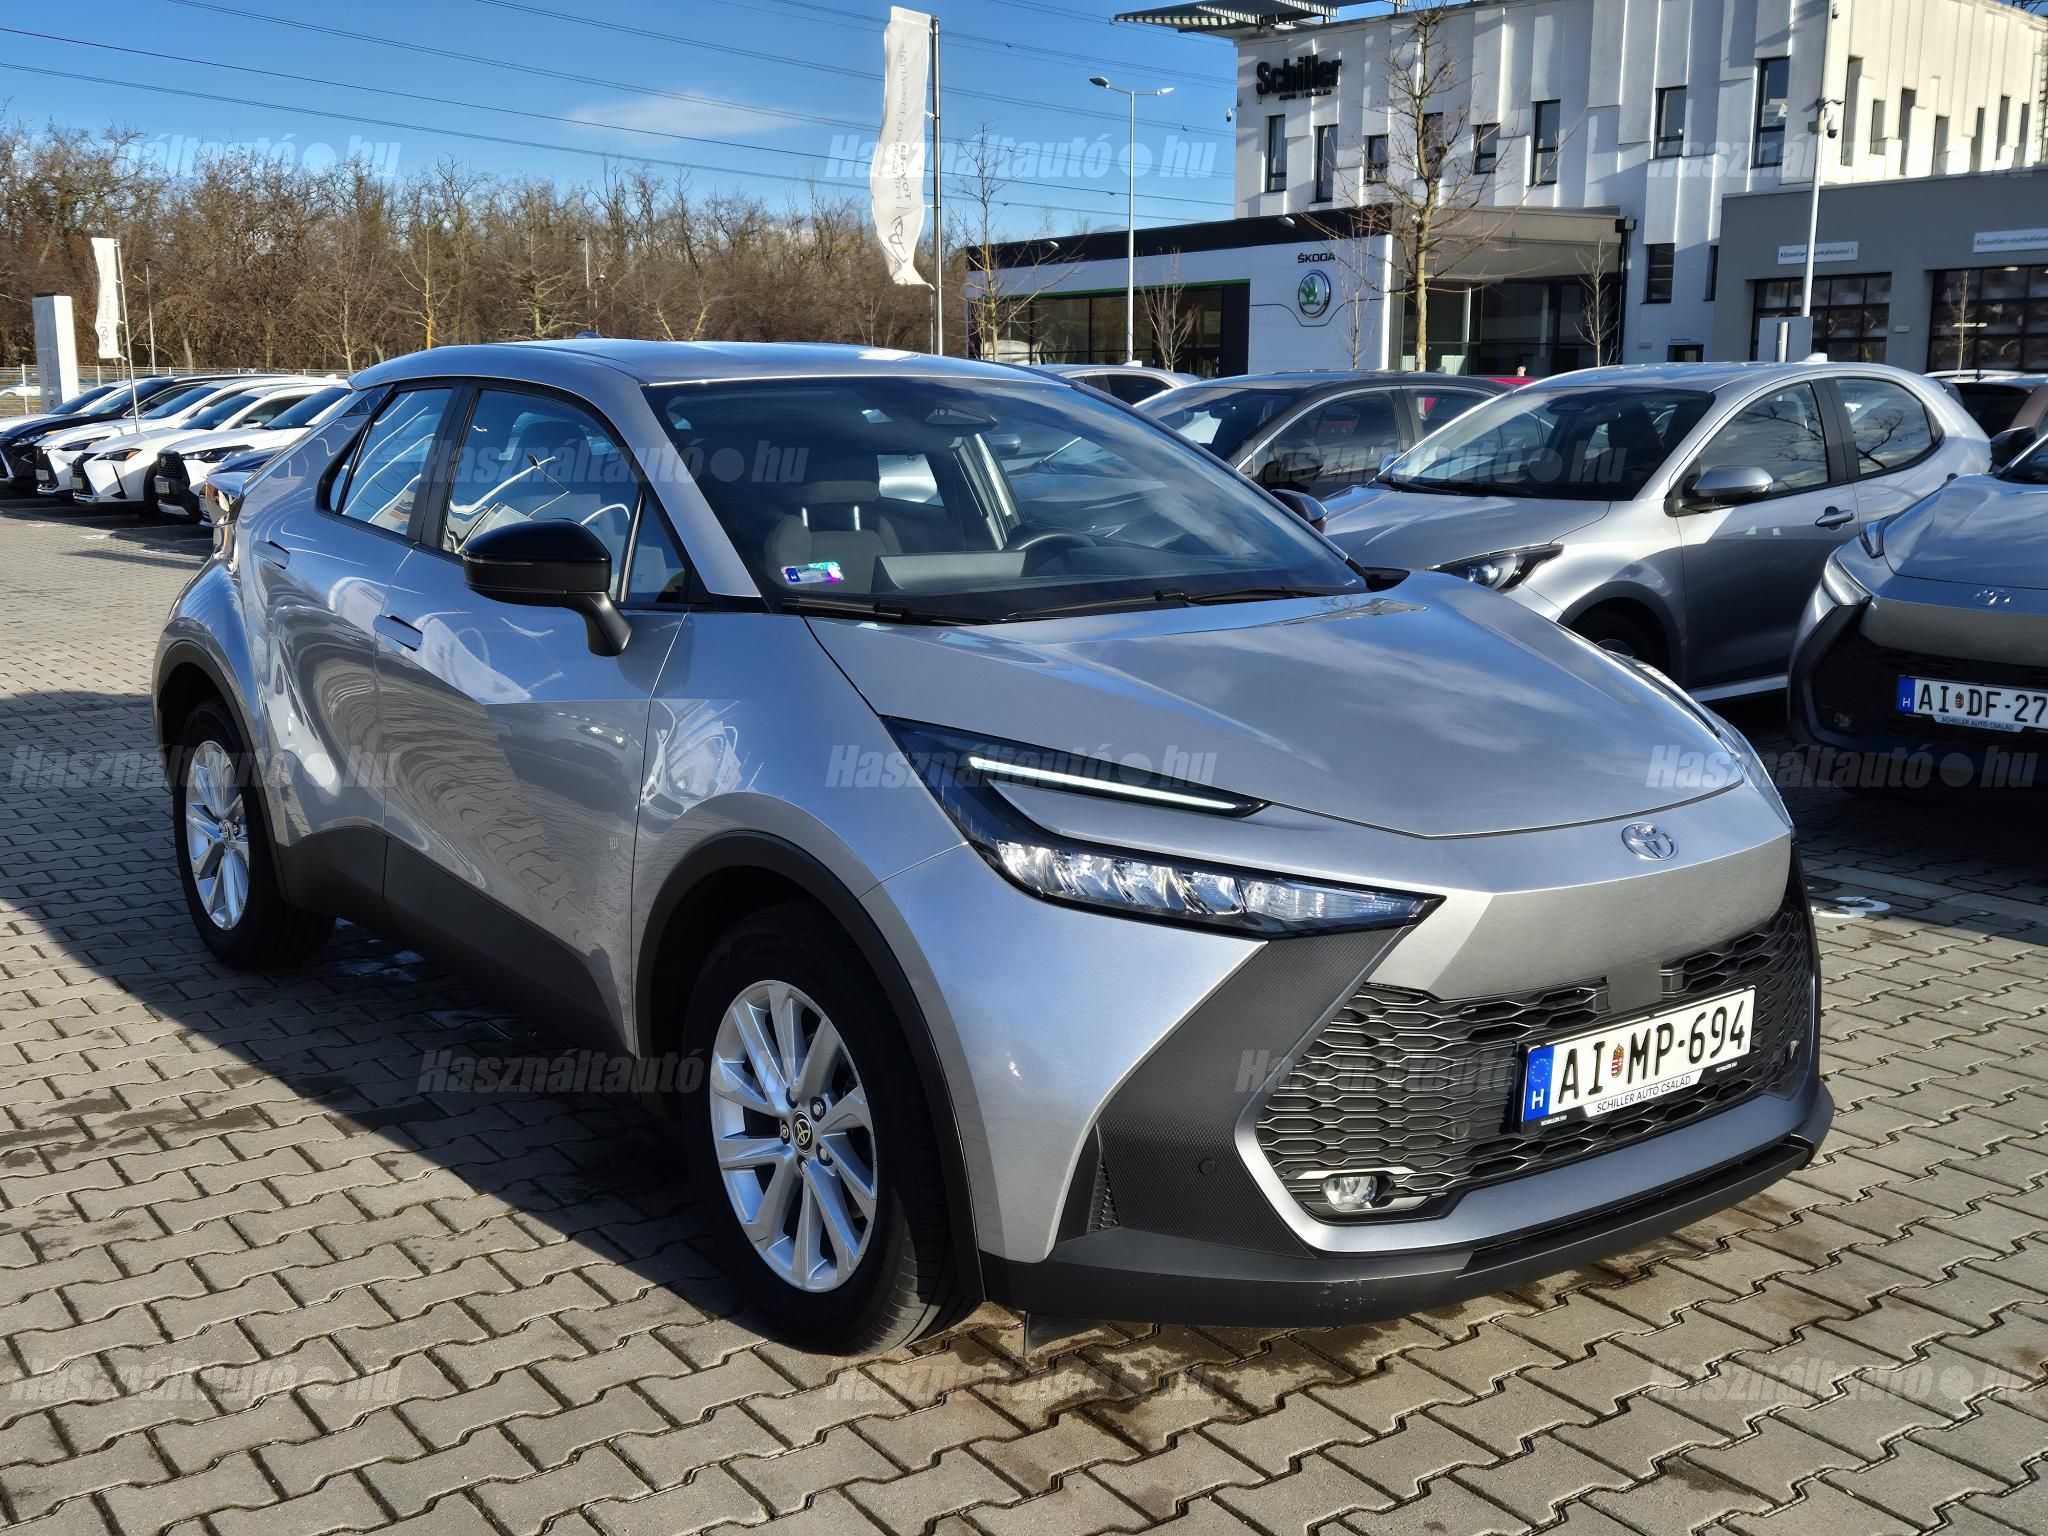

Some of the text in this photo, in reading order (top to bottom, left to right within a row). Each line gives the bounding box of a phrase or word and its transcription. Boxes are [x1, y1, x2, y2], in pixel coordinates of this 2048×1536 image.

[1256, 54, 1342, 95] Schiller
[1902, 697, 1911, 708] H
[1919, 683, 1950, 713] AI
[1531, 999, 1746, 1110] H AI MP-694
[1596, 1075, 1691, 1113] SCHILLER AUTÓ CSALÁD
